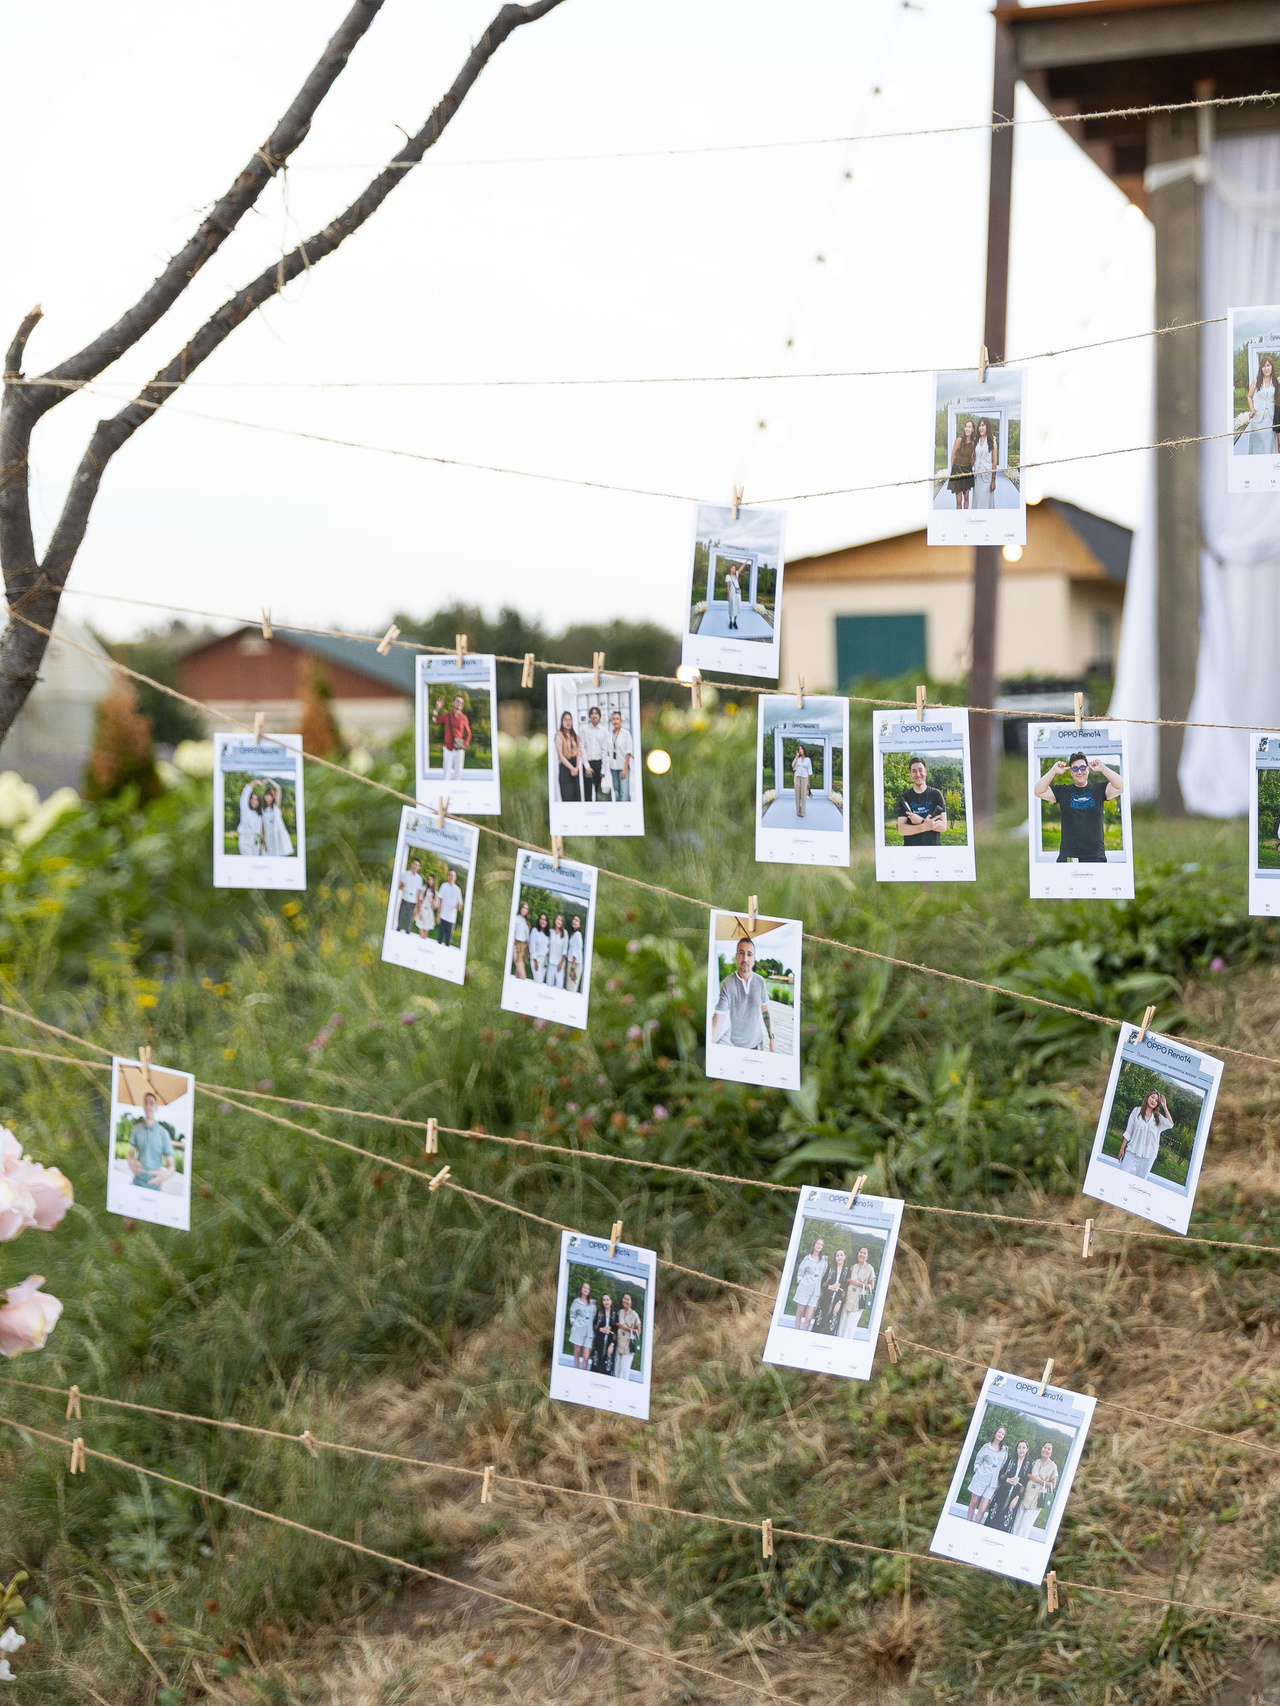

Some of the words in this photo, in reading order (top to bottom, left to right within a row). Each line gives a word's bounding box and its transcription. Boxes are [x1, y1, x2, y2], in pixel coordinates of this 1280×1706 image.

[1078, 730, 1101, 738] Reno14
[1146, 1040, 1167, 1054] OPPO
[1167, 1048, 1192, 1064] Reno14
[588, 1241, 607, 1251] OPPO
[1015, 1382, 1038, 1394] OPPO
